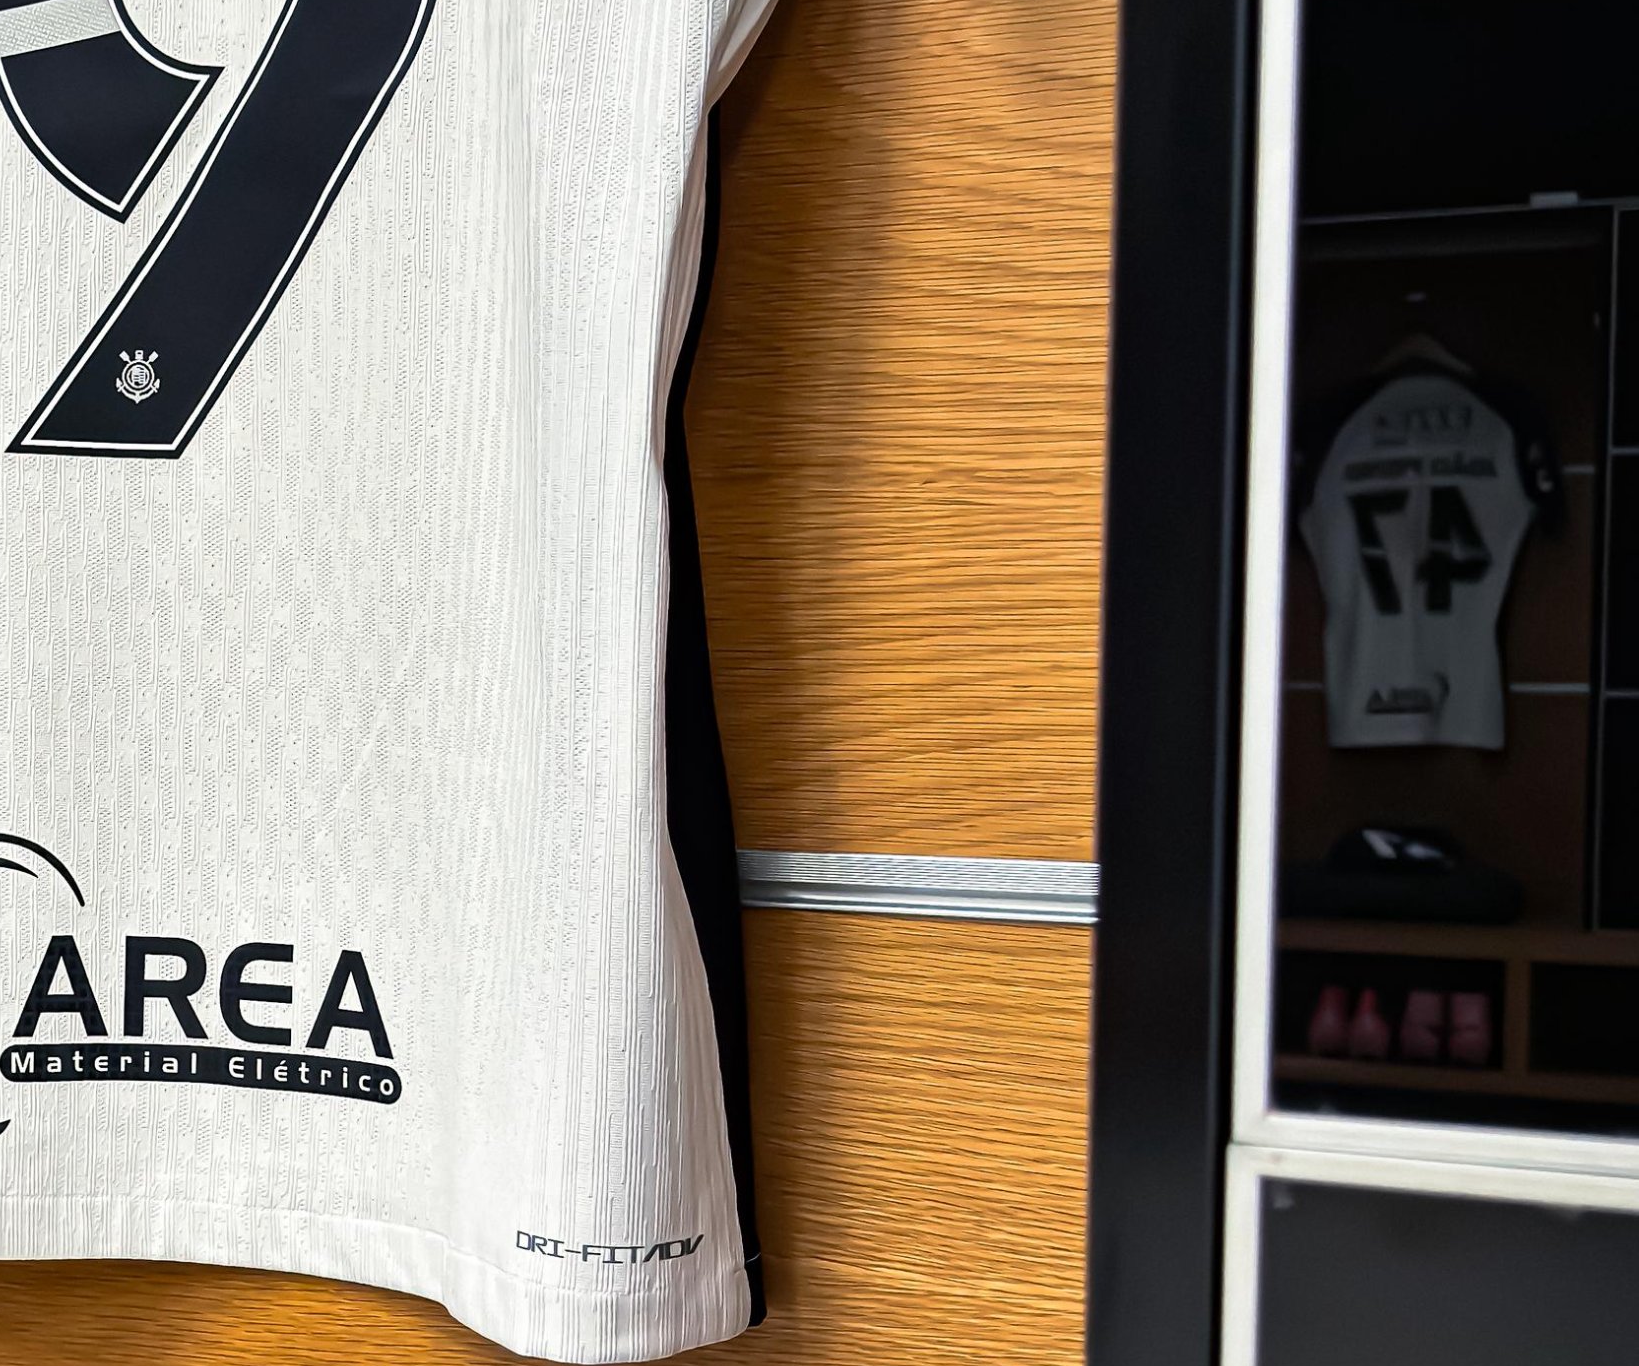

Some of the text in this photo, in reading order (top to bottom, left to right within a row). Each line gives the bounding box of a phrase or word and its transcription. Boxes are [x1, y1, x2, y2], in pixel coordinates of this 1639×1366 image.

[12, 935, 396, 1060] AREA
[10, 1050, 395, 1096] Material Elétrico
